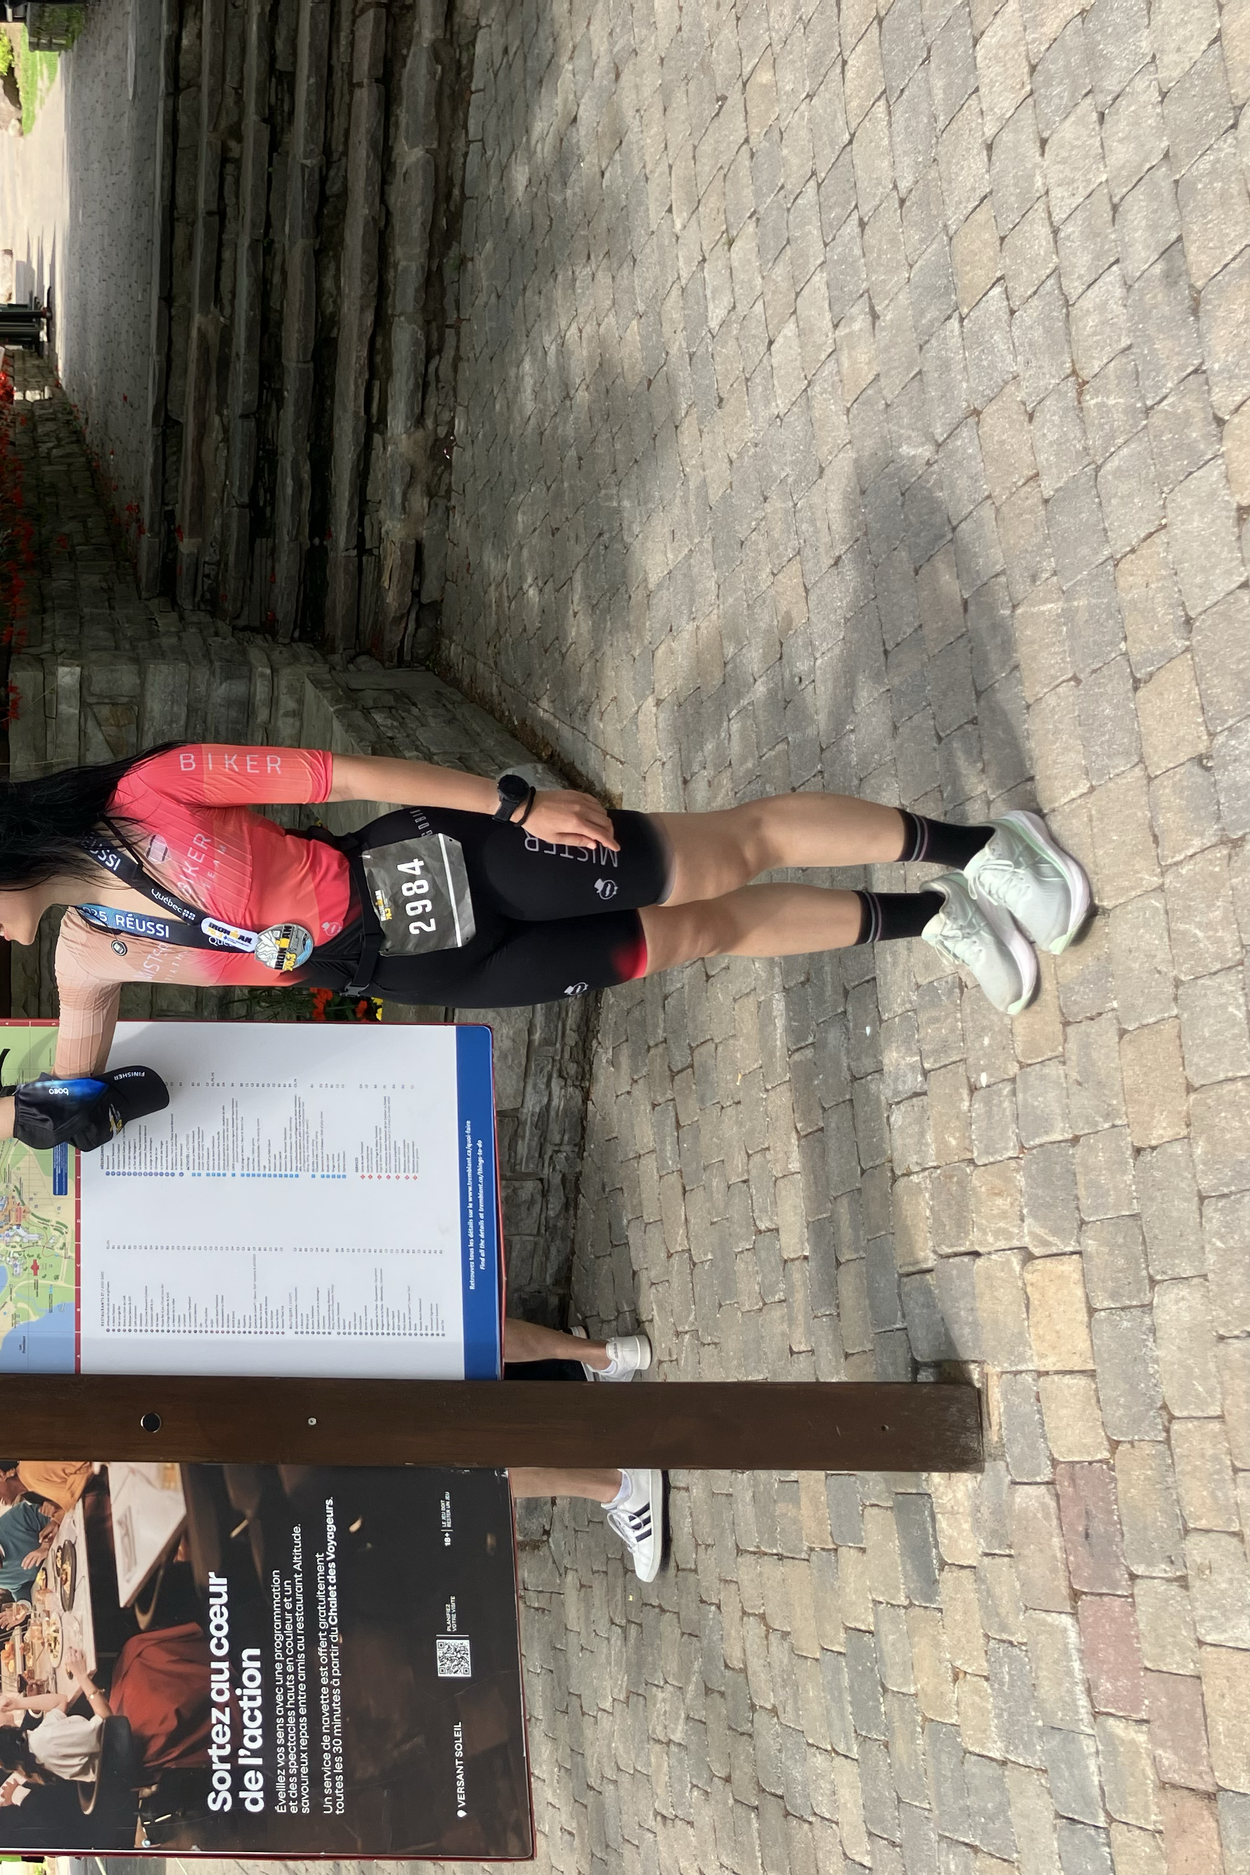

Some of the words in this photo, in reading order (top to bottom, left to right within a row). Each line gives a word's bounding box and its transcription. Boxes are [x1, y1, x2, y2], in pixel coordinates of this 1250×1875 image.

[180, 753, 282, 774] BIKER
[177, 833, 212, 894] BIKER
[203, 844, 226, 888] TEAM
[397, 858, 436, 934] 2984
[116, 914, 170, 938] RÉUSSI
[284, 952, 297, 971] 70.3
[114, 1072, 146, 1080] FINISHER
[465, 1120, 473, 1202] www.tremblant.ca/quoi-faire
[325, 1496, 337, 1560] Voyageurs.
[292, 1524, 302, 1571] Altitude.
[284, 1580, 292, 1595] un
[327, 1562, 336, 1583] des
[283, 1597, 292, 1610] et
[294, 1573, 304, 1633] restaurant
[315, 1552, 328, 1629] gratuitement
[327, 1585, 338, 1625] Chalet
[208, 1572, 228, 1656] cœur
[271, 1570, 284, 1660] programmation
[284, 1612, 294, 1655] couleur
[297, 1636, 305, 1651] au
[318, 1631, 328, 1664] offert
[329, 1627, 339, 1642] du
[275, 1662, 283, 1684] une
[286, 1658, 294, 1672] en
[296, 1653, 306, 1681] amis
[319, 1666, 329, 1684] est
[330, 1644, 342, 1676] partir
[210, 1662, 230, 1702] au
[285, 1674, 296, 1708] hauts
[297, 1683, 307, 1715] entre
[330, 1678, 340, 1686] à
[235, 1648, 262, 1765] l’action
[276, 1687, 284, 1715] avec
[320, 1687, 330, 1732] navette
[332, 1688, 342, 1736] minutes
[276, 1718, 285, 1744] sens
[286, 1710, 298, 1774] spectacles
[299, 1716, 309, 1750] repas
[321, 1734, 331, 1750] de
[333, 1738, 342, 1754] 30
[454, 1722, 464, 1757] SOLEIL
[207, 1708, 232, 1812] Sortez
[276, 1746, 285, 1767] vos
[322, 1752, 332, 1794] service
[334, 1756, 343, 1772] les
[238, 1770, 264, 1812] de
[275, 1769, 287, 1813] Éveillez
[288, 1776, 298, 1798] des
[300, 1752, 310, 1814] savoureux
[334, 1774, 344, 1815] toutes
[456, 1759, 466, 1808] VERSANT
[288, 1800, 298, 1814] et
[323, 1796, 333, 1814] Un
